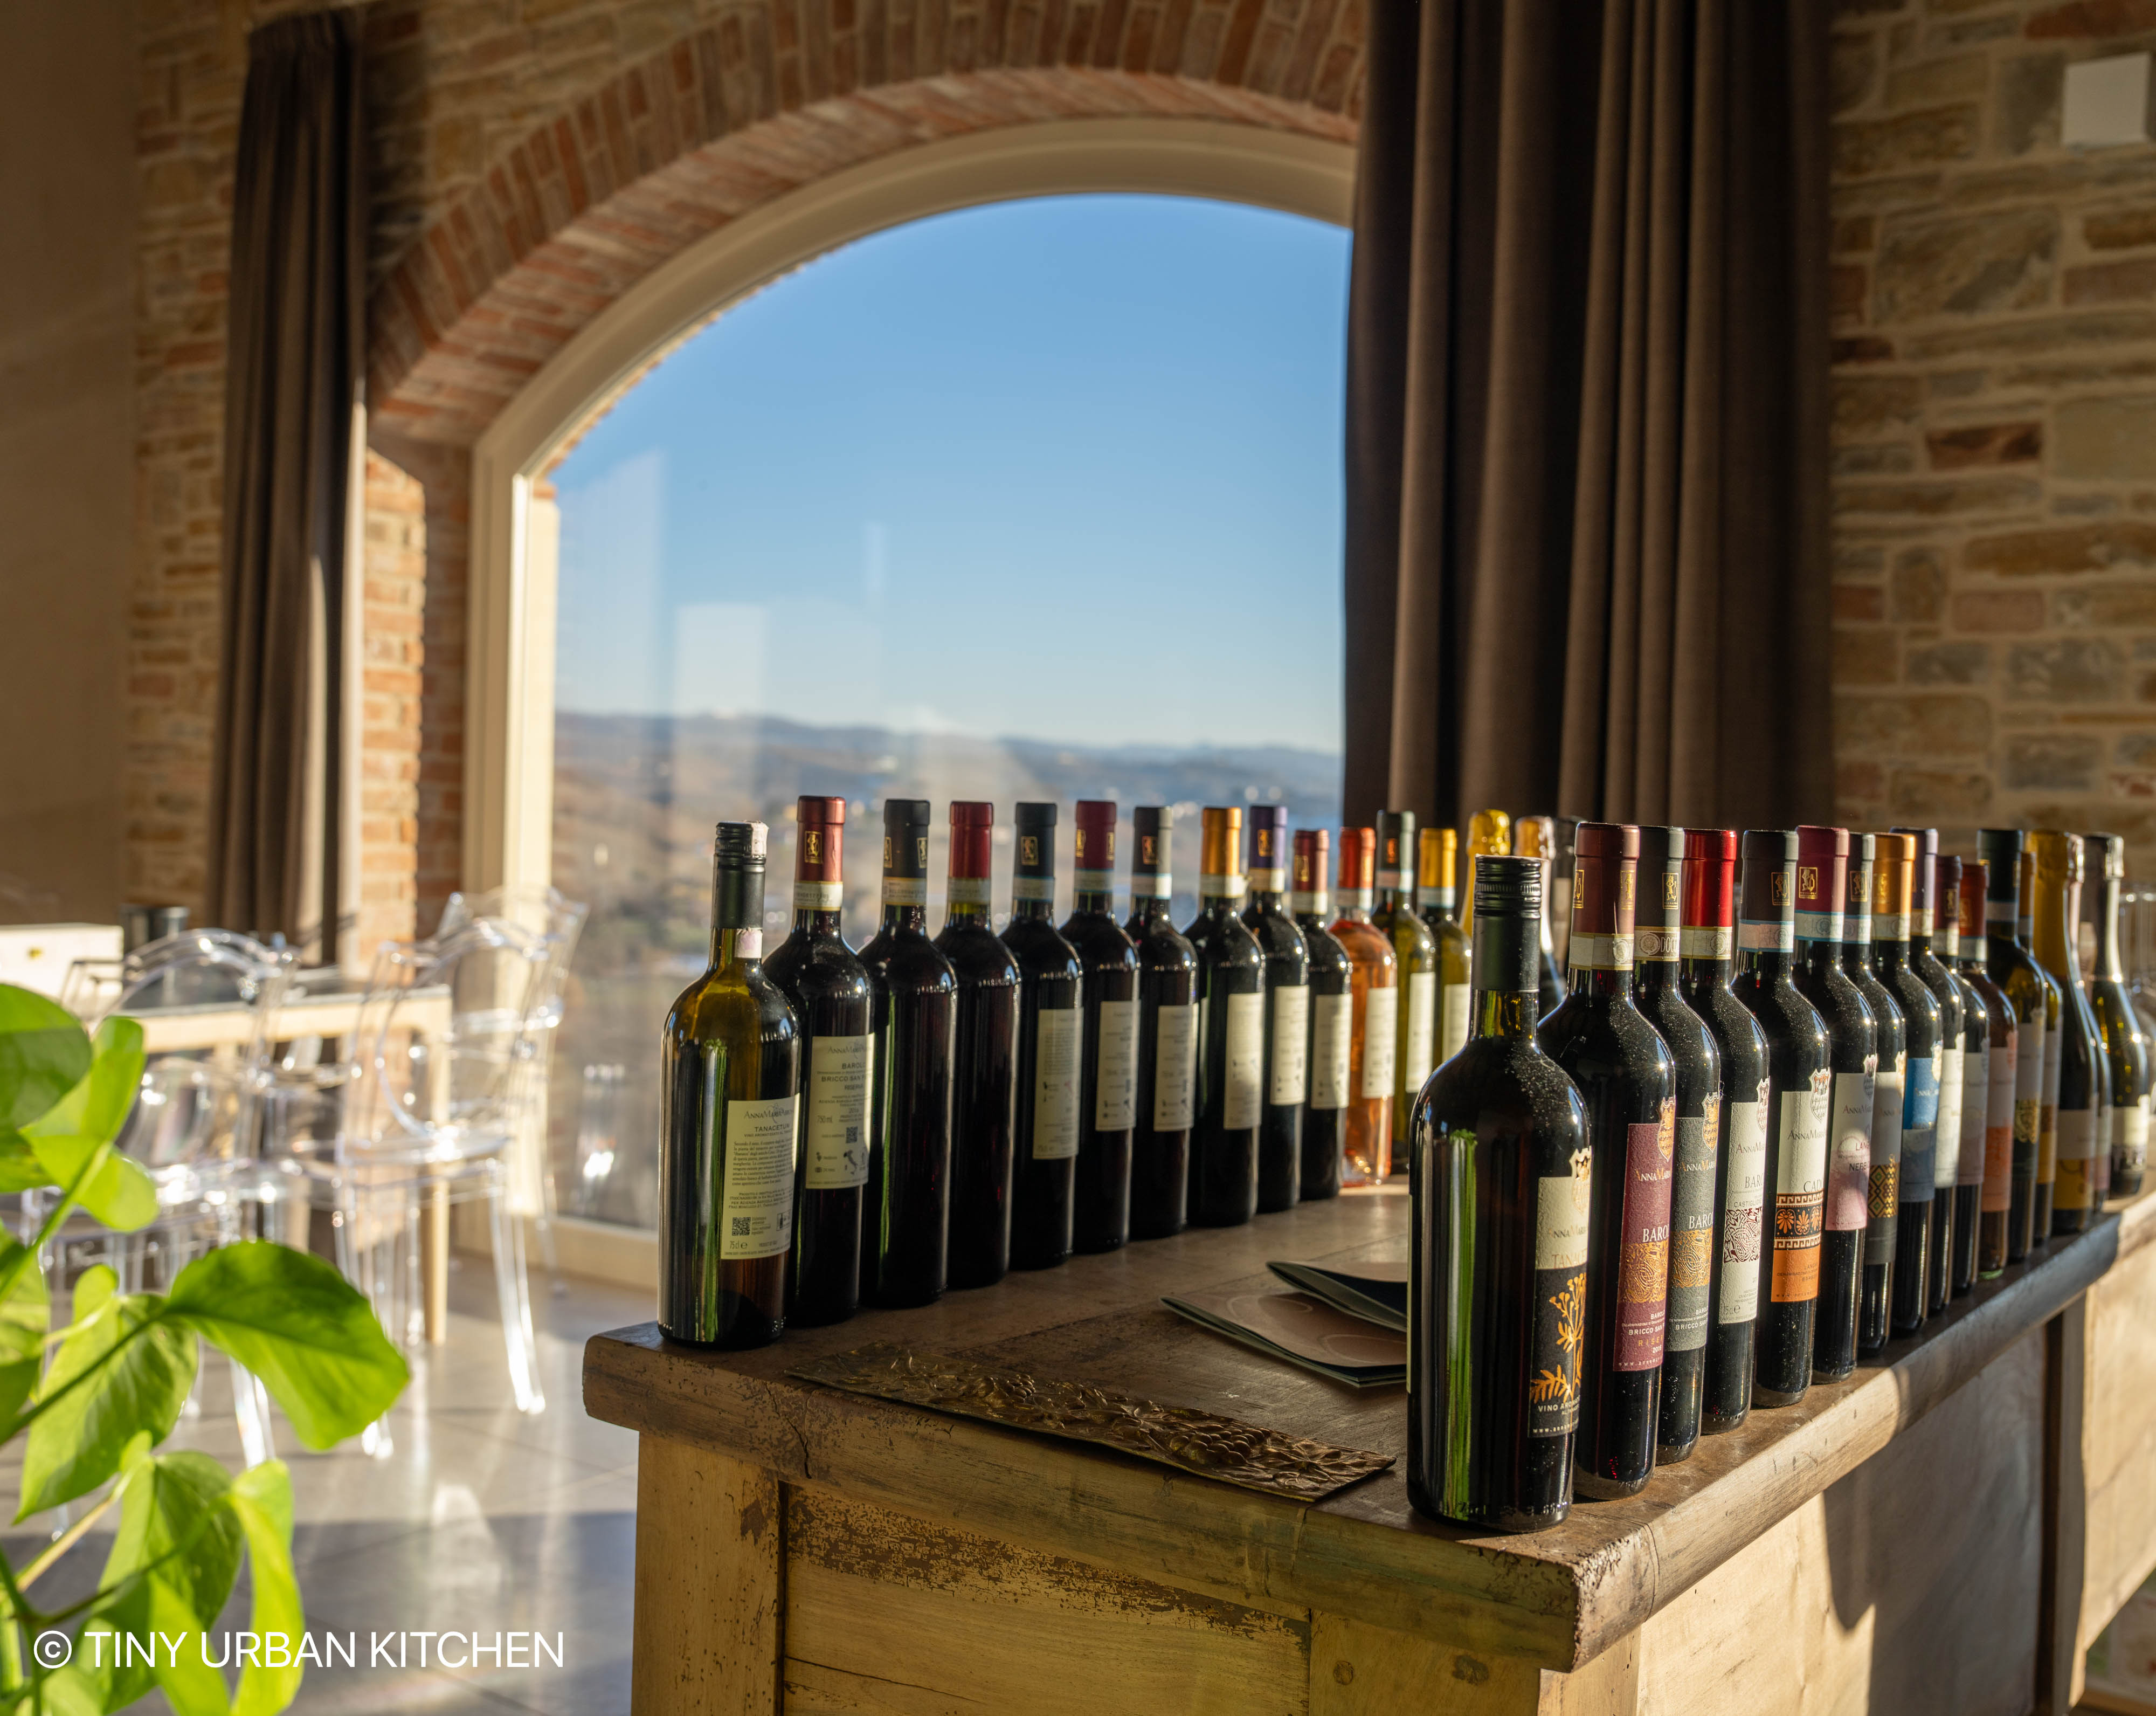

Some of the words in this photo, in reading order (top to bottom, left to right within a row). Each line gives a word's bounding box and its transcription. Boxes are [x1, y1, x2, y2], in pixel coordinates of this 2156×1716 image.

[1675, 1322, 1698, 1331] BRICCO
[1628, 1327, 1654, 1335] BRICCO
[1538, 1404, 1558, 1412] VINO
